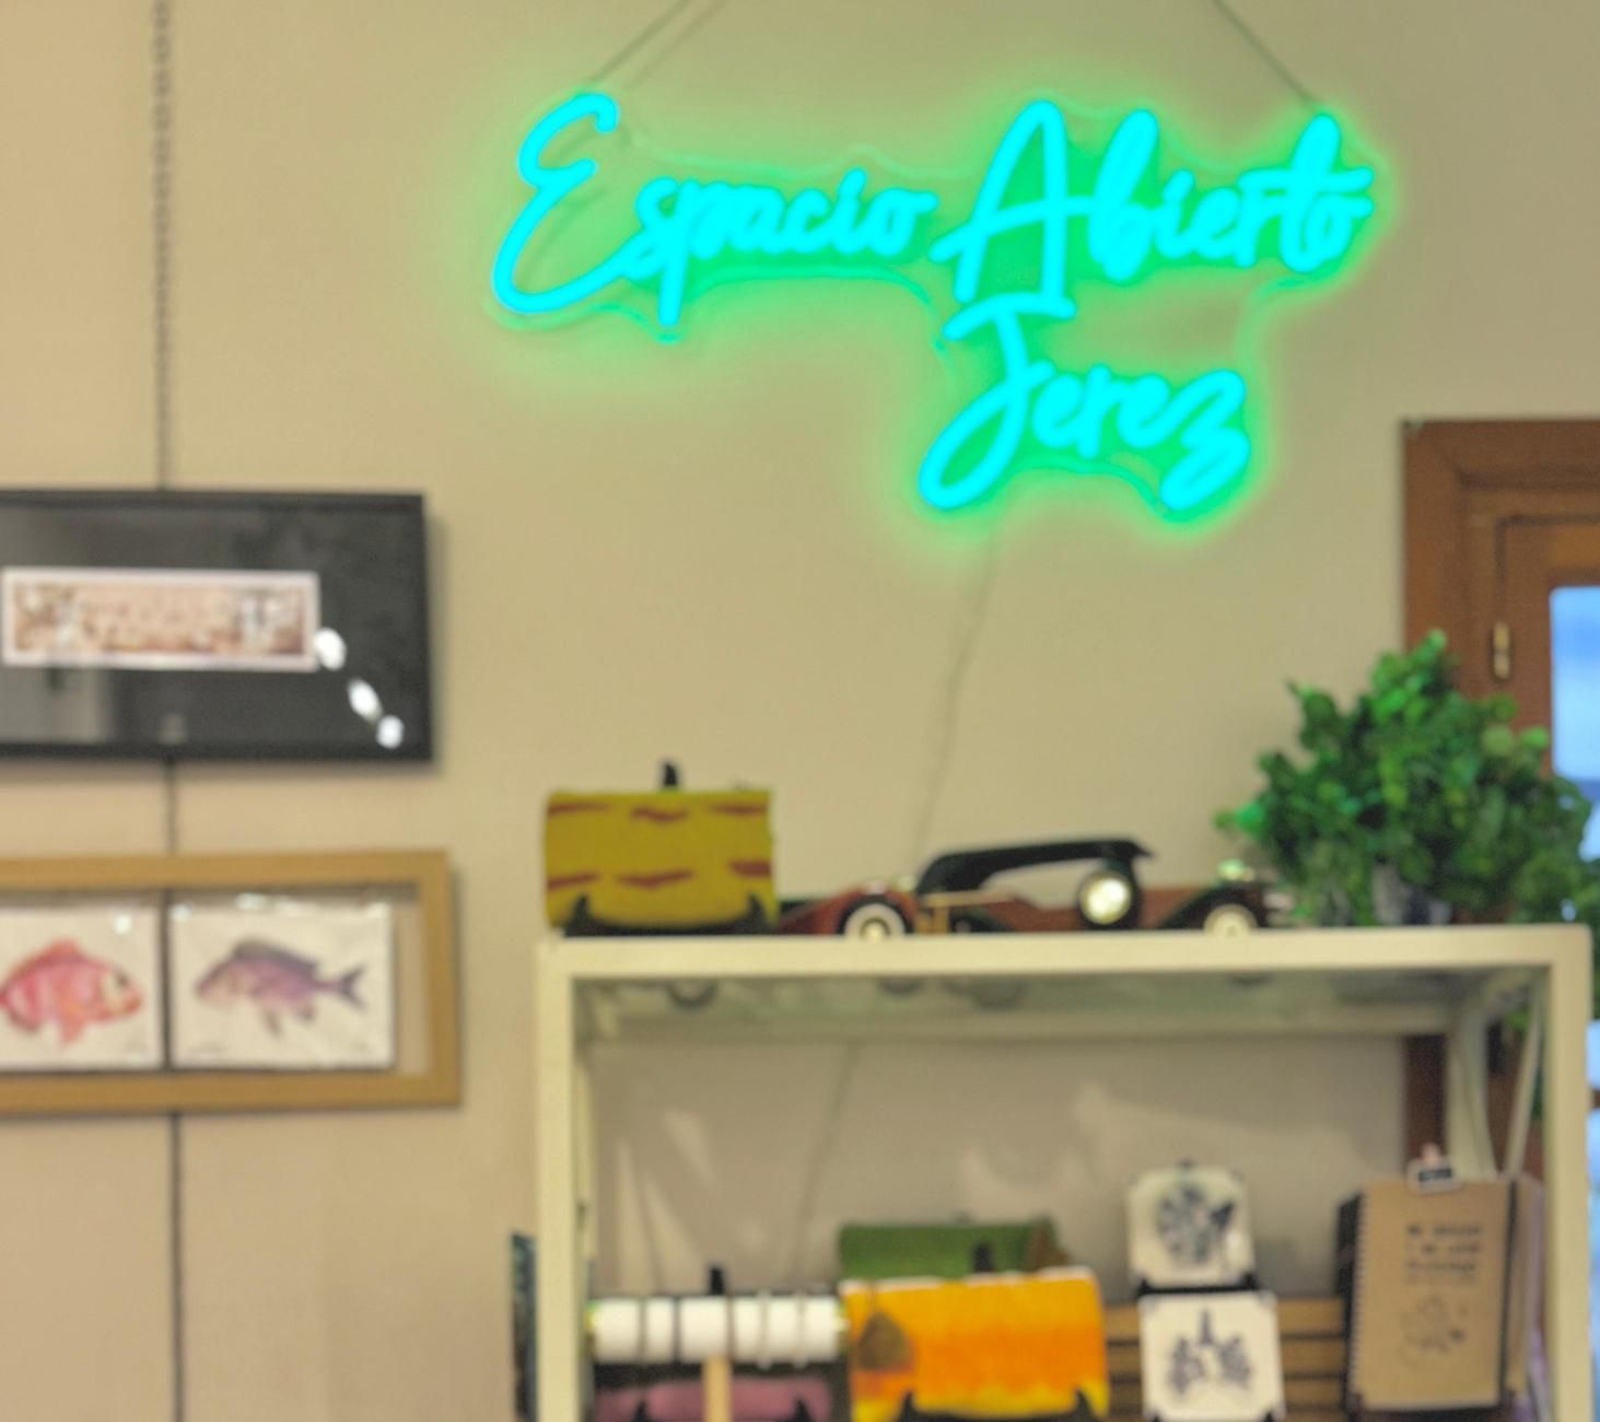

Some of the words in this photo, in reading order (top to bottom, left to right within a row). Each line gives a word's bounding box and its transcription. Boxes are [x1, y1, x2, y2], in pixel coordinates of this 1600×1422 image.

[493, 94, 937, 327] Espacio
[928, 101, 1374, 305] Abierto
[918, 291, 1251, 510] Jerez
